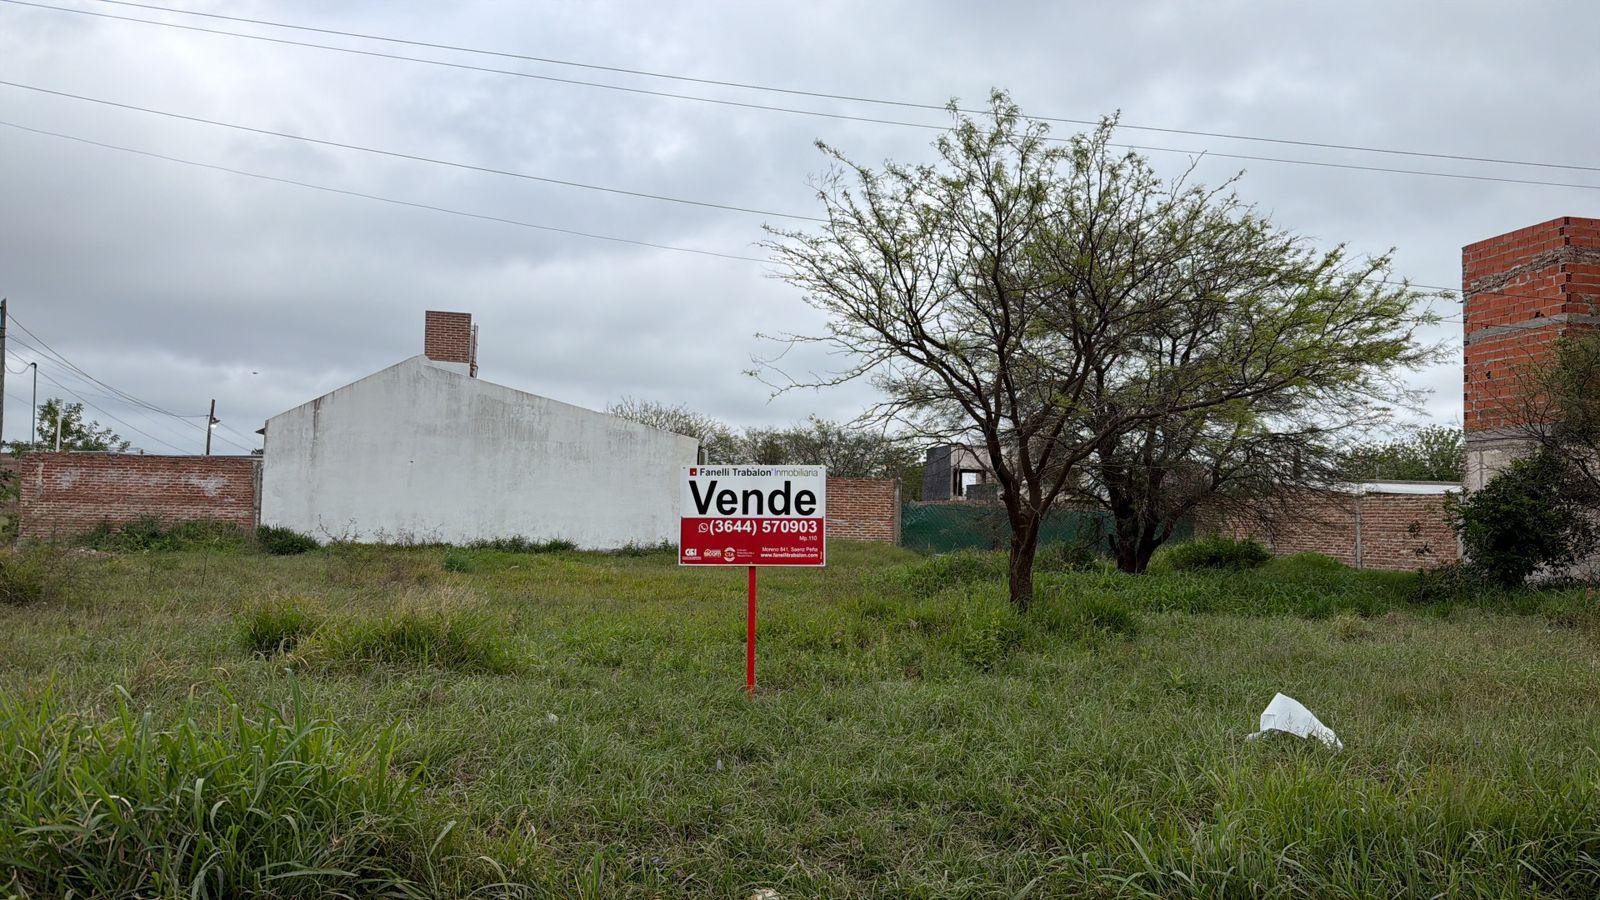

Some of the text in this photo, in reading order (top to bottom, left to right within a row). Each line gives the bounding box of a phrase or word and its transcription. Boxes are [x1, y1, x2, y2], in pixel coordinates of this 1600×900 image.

[699, 467, 730, 477] Fanelli
[774, 468, 818, 477] Inmobiliaria
[688, 480, 817, 516] Vende
[709, 519, 818, 536] (3644) 570903
